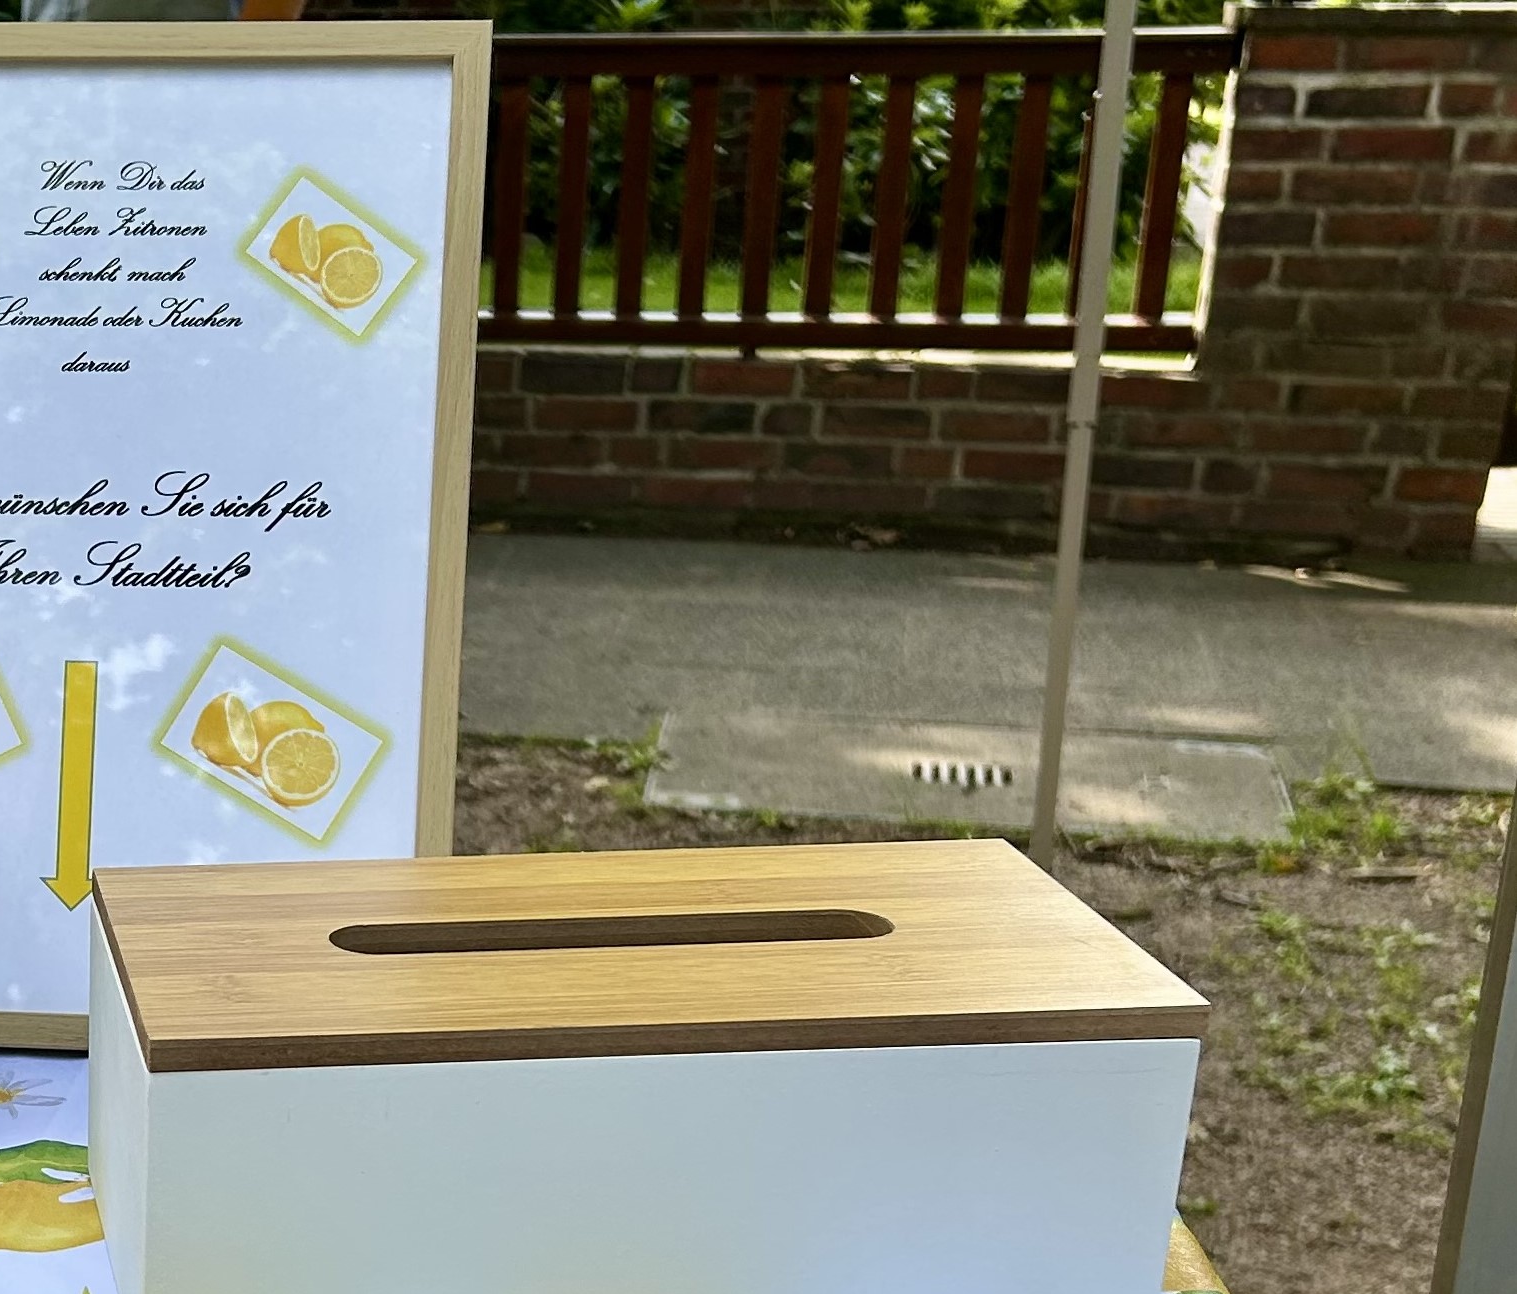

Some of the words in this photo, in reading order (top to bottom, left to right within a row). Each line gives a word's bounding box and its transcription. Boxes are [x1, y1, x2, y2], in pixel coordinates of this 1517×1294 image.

[40, 159, 106, 192] Wenn
[115, 160, 167, 192] Dir
[170, 169, 205, 192] das
[23, 205, 100, 236] Leben
[107, 207, 208, 237] Zitronen
[126, 257, 197, 282] mach
[102, 306, 144, 328] oder
[148, 297, 244, 328] Kuchen
[61, 351, 131, 373] daraus
[140, 471, 210, 518] Sie
[210, 480, 287, 519] sich
[264, 482, 333, 532] für
[74, 541, 252, 590] Stadtteil?
